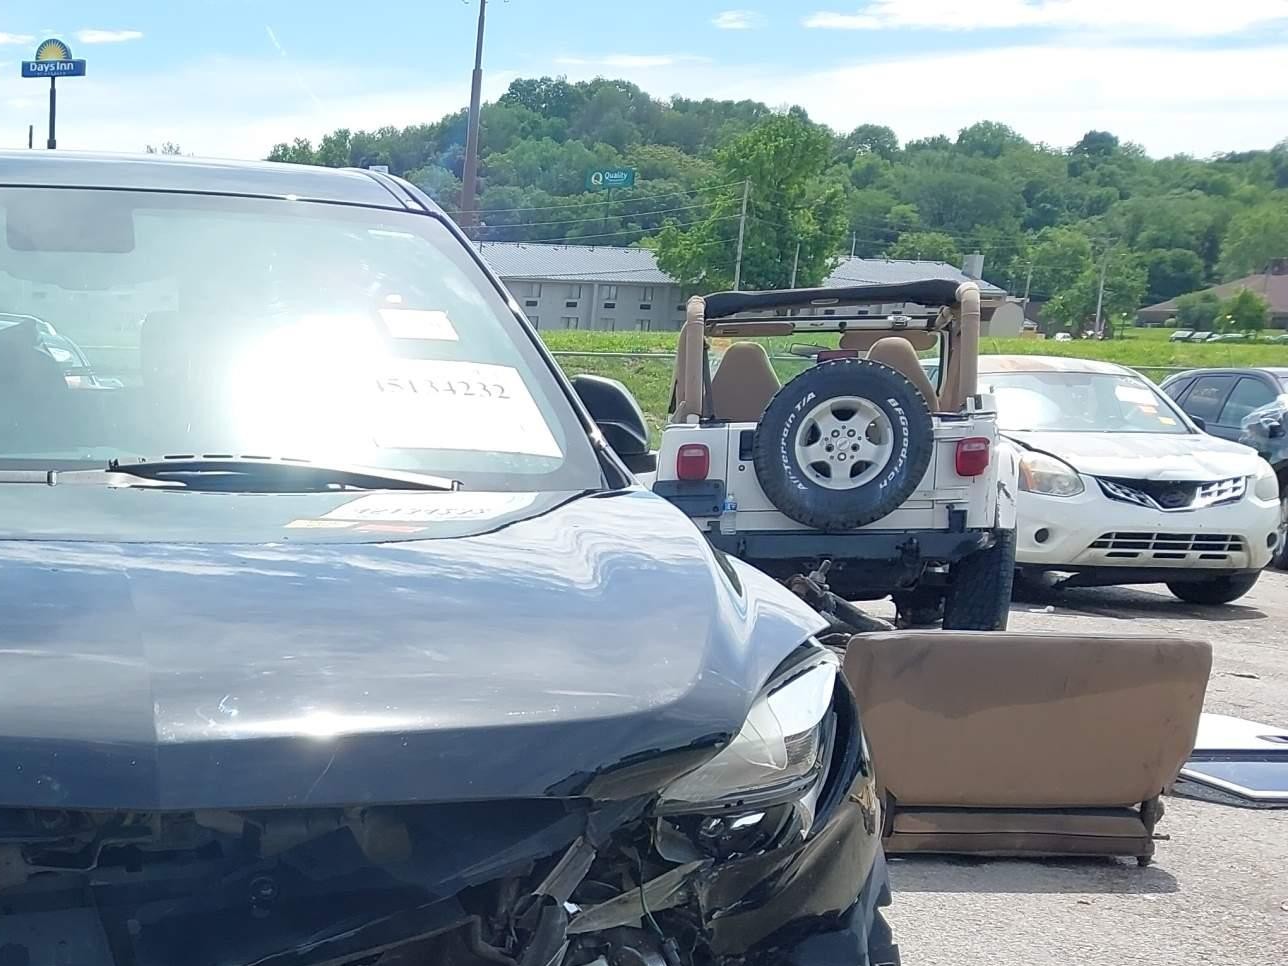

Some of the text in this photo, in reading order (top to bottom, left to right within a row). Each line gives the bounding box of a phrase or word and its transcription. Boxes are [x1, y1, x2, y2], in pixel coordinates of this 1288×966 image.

[29, 61, 74, 72] Days Inn
[604, 171, 628, 180] Quality
[780, 392, 816, 491] All-Terrain T/A
[880, 398, 909, 489] BFGoodrich
